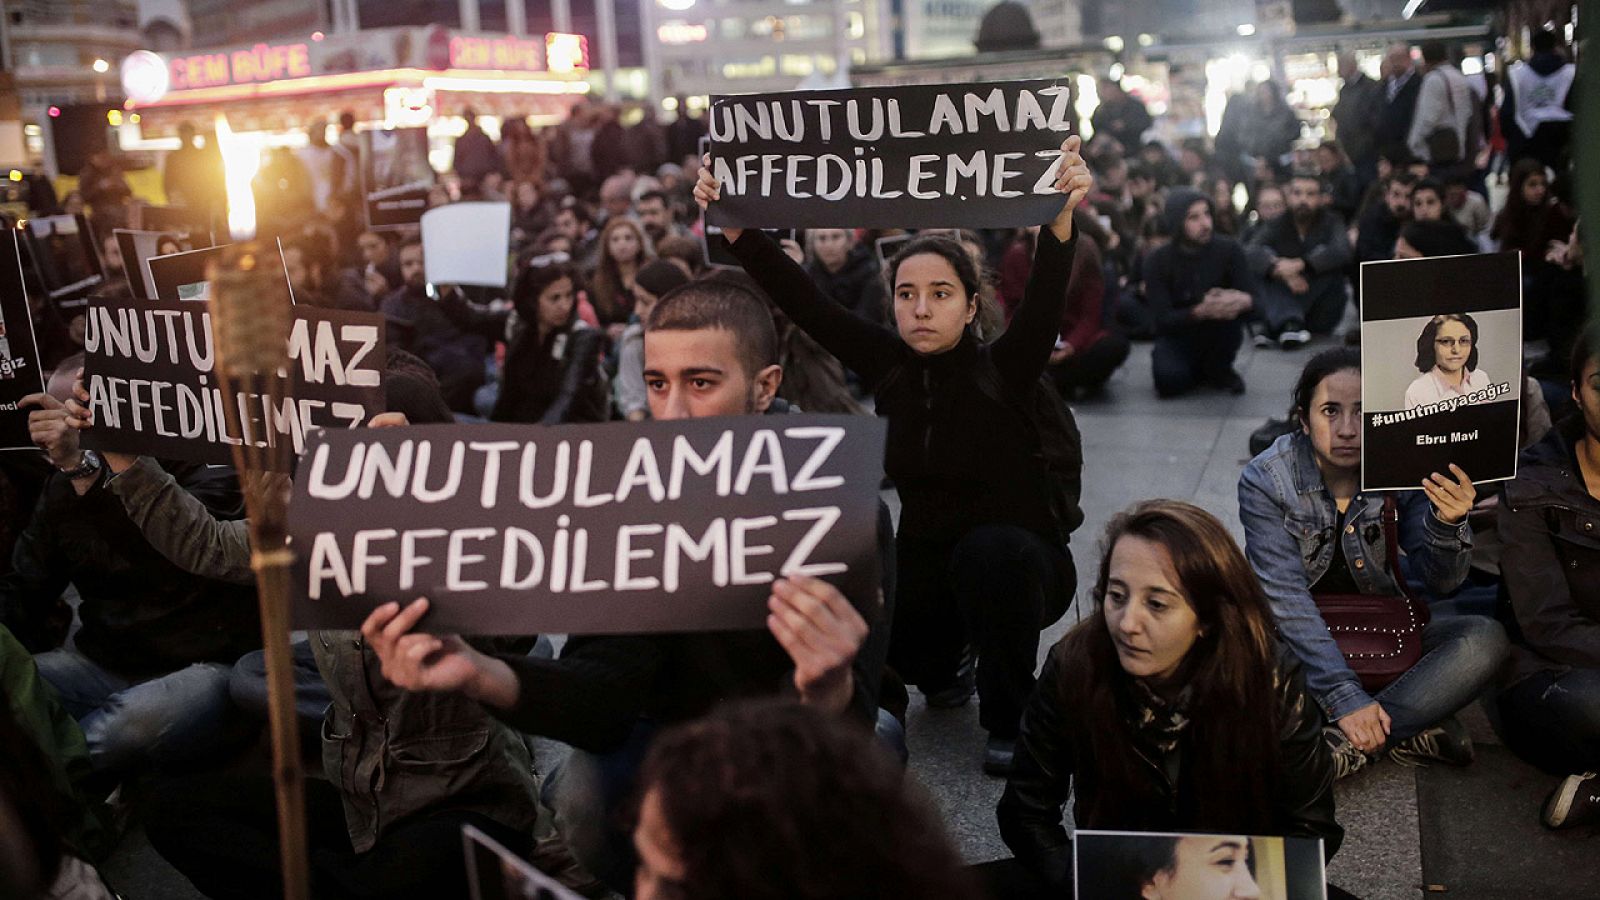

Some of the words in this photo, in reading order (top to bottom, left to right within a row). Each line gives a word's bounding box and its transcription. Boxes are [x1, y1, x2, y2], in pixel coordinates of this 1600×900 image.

[170, 54, 230, 89] CEM
[231, 43, 311, 83] BÜFE
[709, 86, 1071, 144] UNUTULAMAZ
[713, 146, 1067, 200] AFFEDİLEMEZ
[84, 306, 381, 387] UNUTUMAZ
[1371, 382, 1511, 427] #unutmayacağız
[1416, 434, 1447, 446] Ebru
[1450, 430, 1479, 444] Mavi
[308, 427, 846, 508] UNUTULAMAZ
[308, 506, 848, 599] AFFEDİLEMEZ
